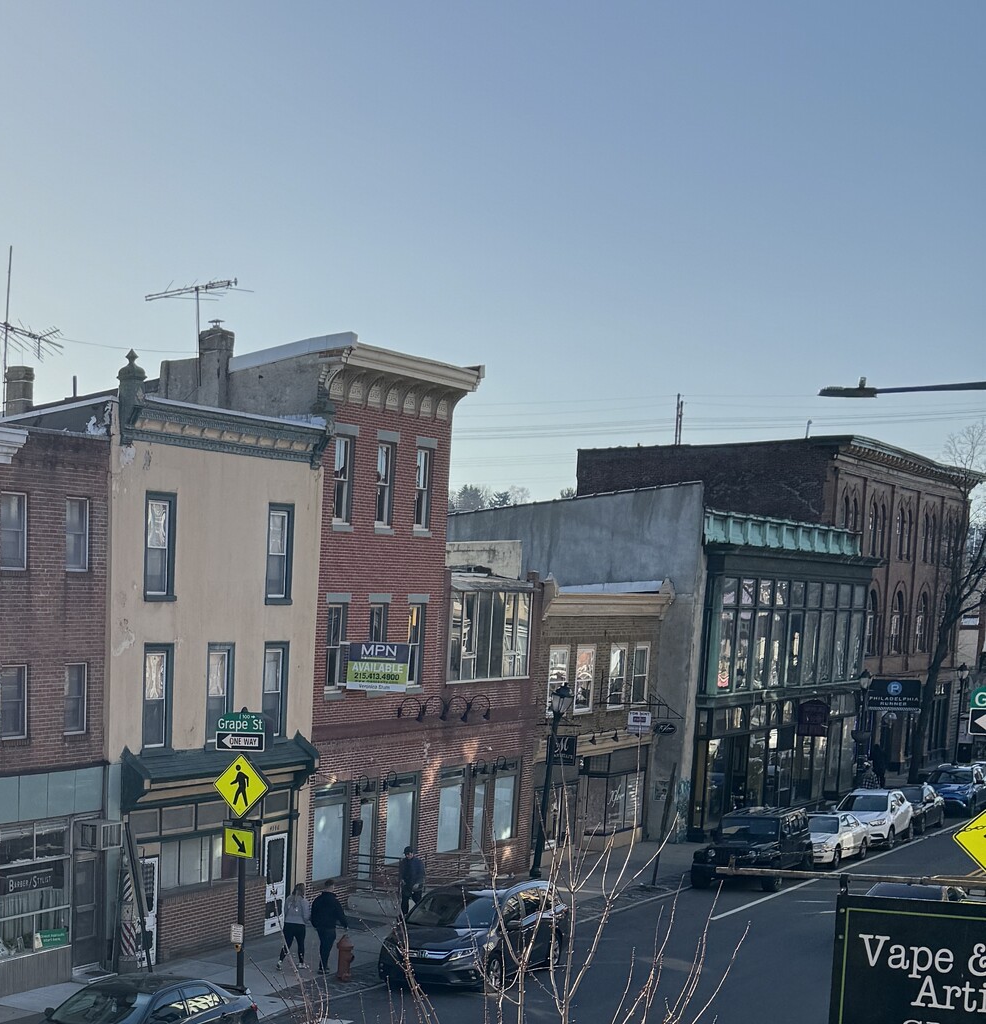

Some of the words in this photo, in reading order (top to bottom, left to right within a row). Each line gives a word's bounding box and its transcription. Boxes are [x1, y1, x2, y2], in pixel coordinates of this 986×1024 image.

[361, 644, 397, 656] MPN
[352, 662, 404, 673] AVAILABLE
[354, 672, 400, 680] 215.413.4900
[217, 718, 249, 732] Grape
[252, 719, 263, 730] St
[229, 737, 242, 745] ONE
[243, 738, 257, 746] WAY
[858, 933, 954, 979] Vape
[967, 943, 986, 977] &
[910, 975, 986, 1013] Arti
